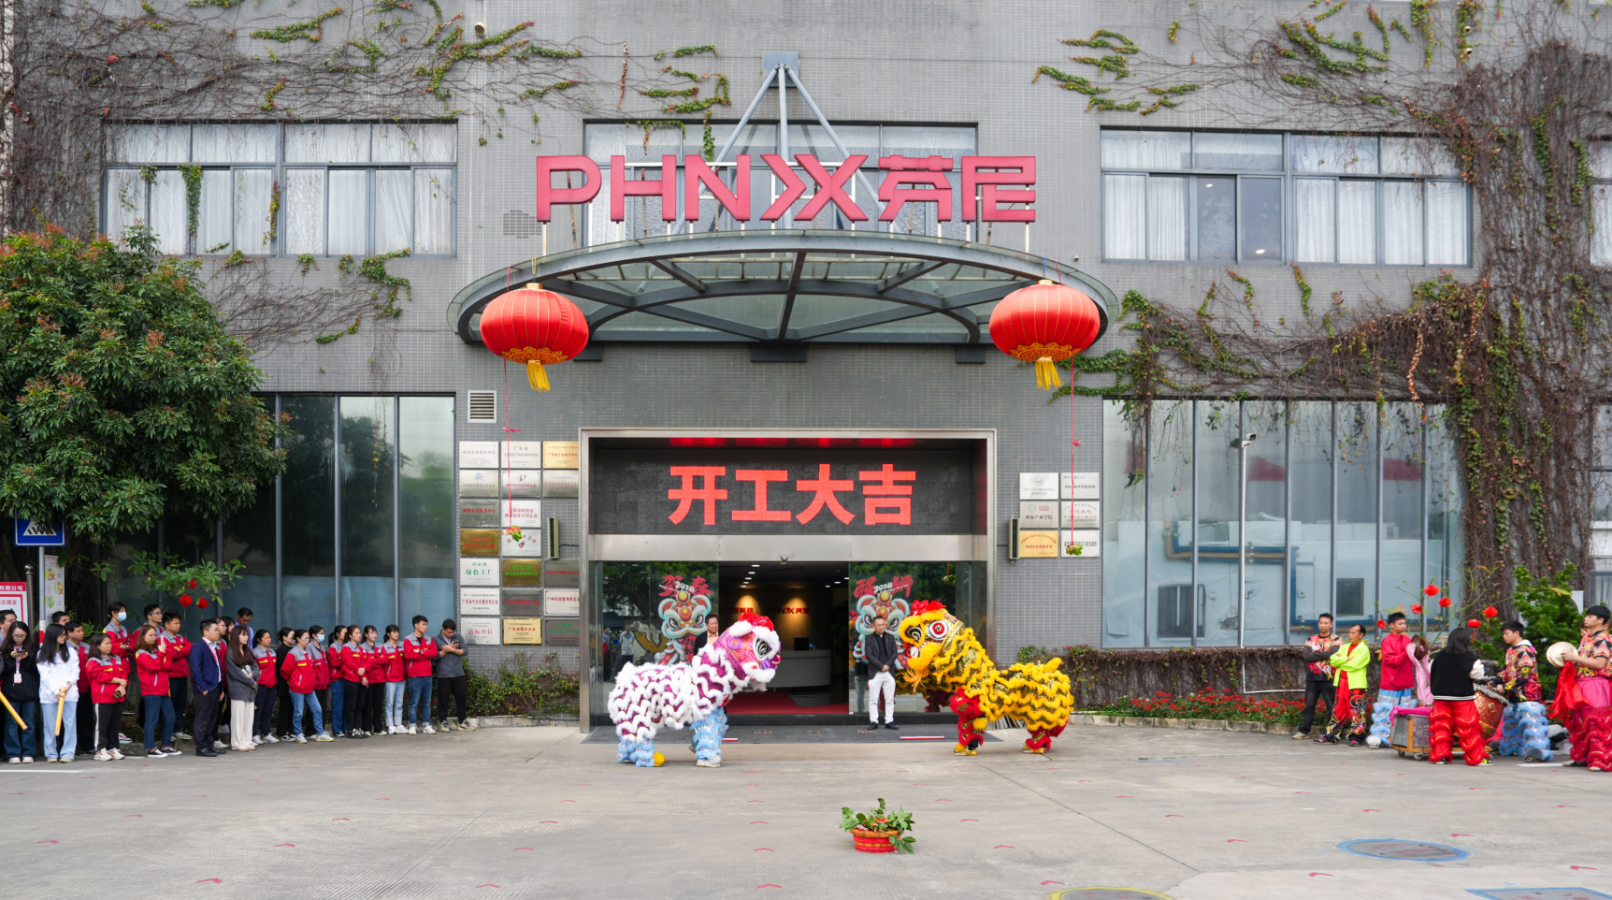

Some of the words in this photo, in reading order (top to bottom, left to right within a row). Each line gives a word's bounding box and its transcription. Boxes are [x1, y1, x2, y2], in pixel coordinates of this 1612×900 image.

[878, 154, 1037, 223] 芬尼
[668, 463, 917, 526] 开工大吉
[465, 568, 494, 576] 绿色工厂
